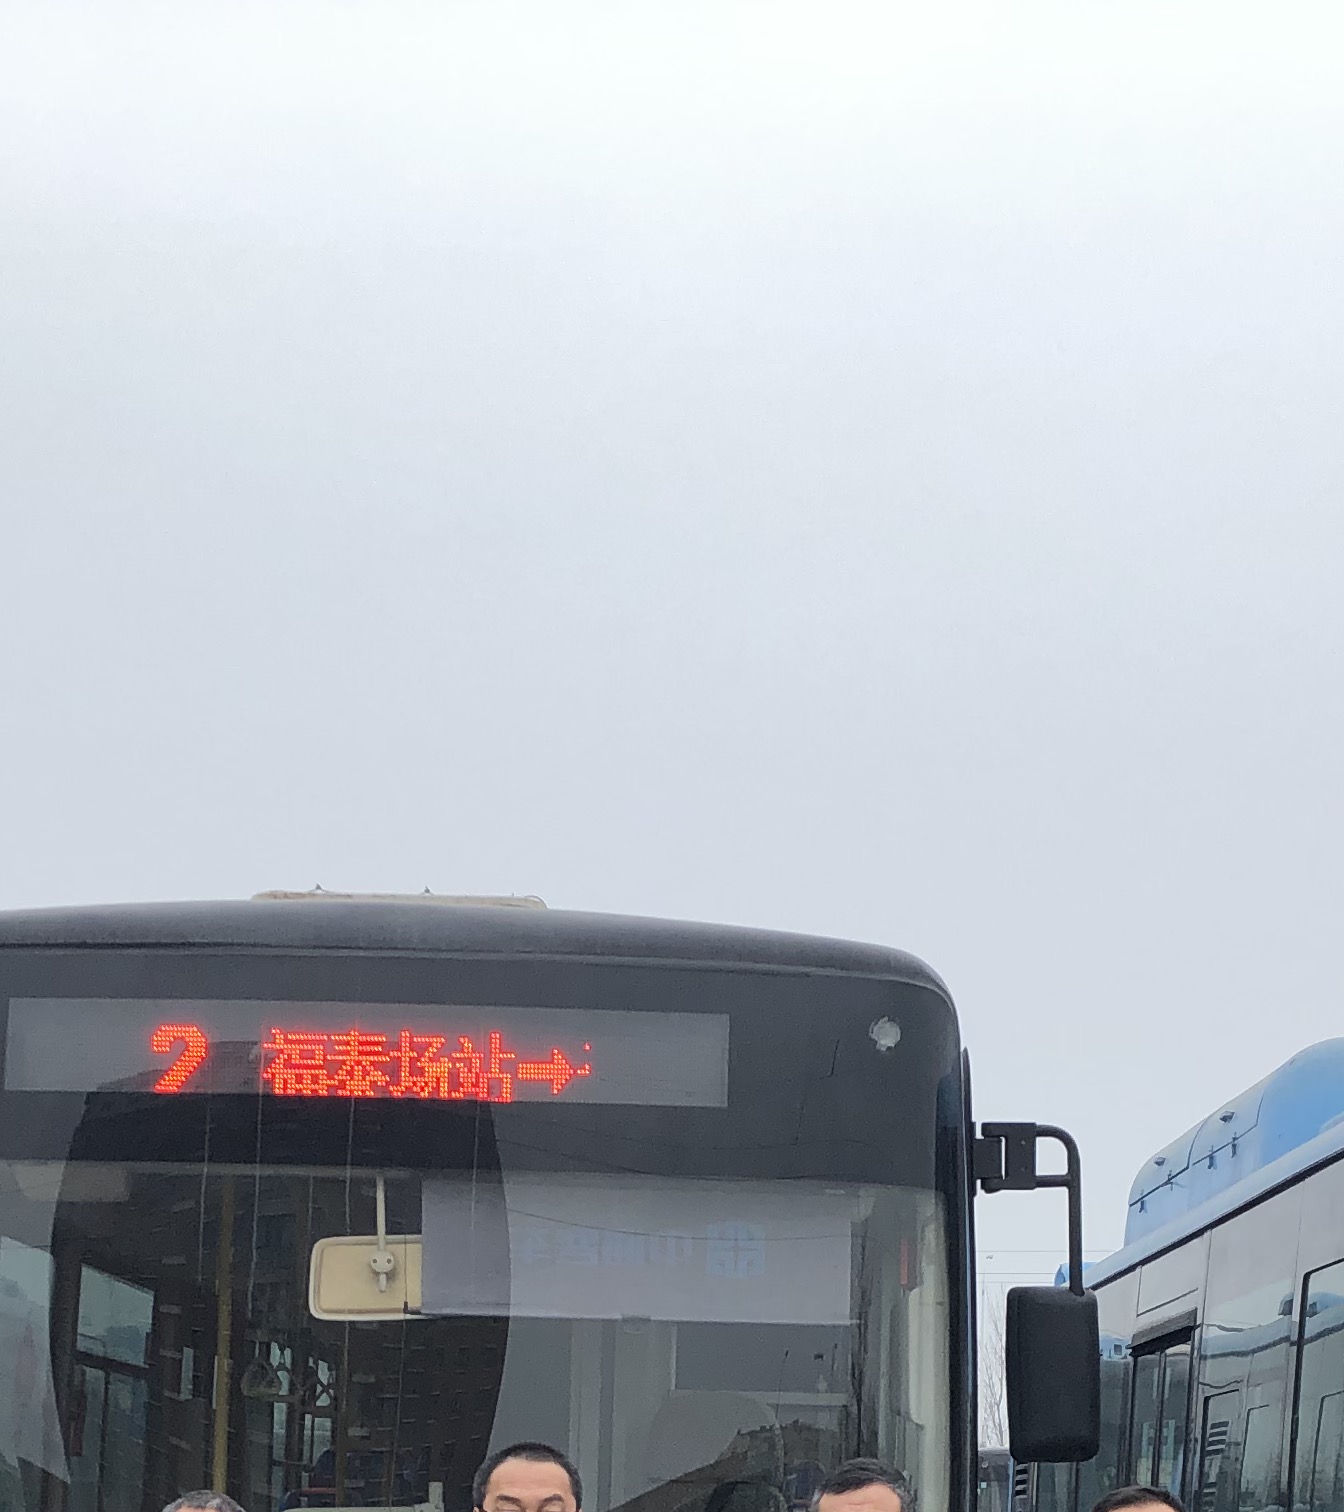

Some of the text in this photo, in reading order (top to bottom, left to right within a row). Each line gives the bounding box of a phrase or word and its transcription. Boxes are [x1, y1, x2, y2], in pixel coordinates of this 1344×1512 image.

[153, 1024, 516, 1102] 2 福泰场站
